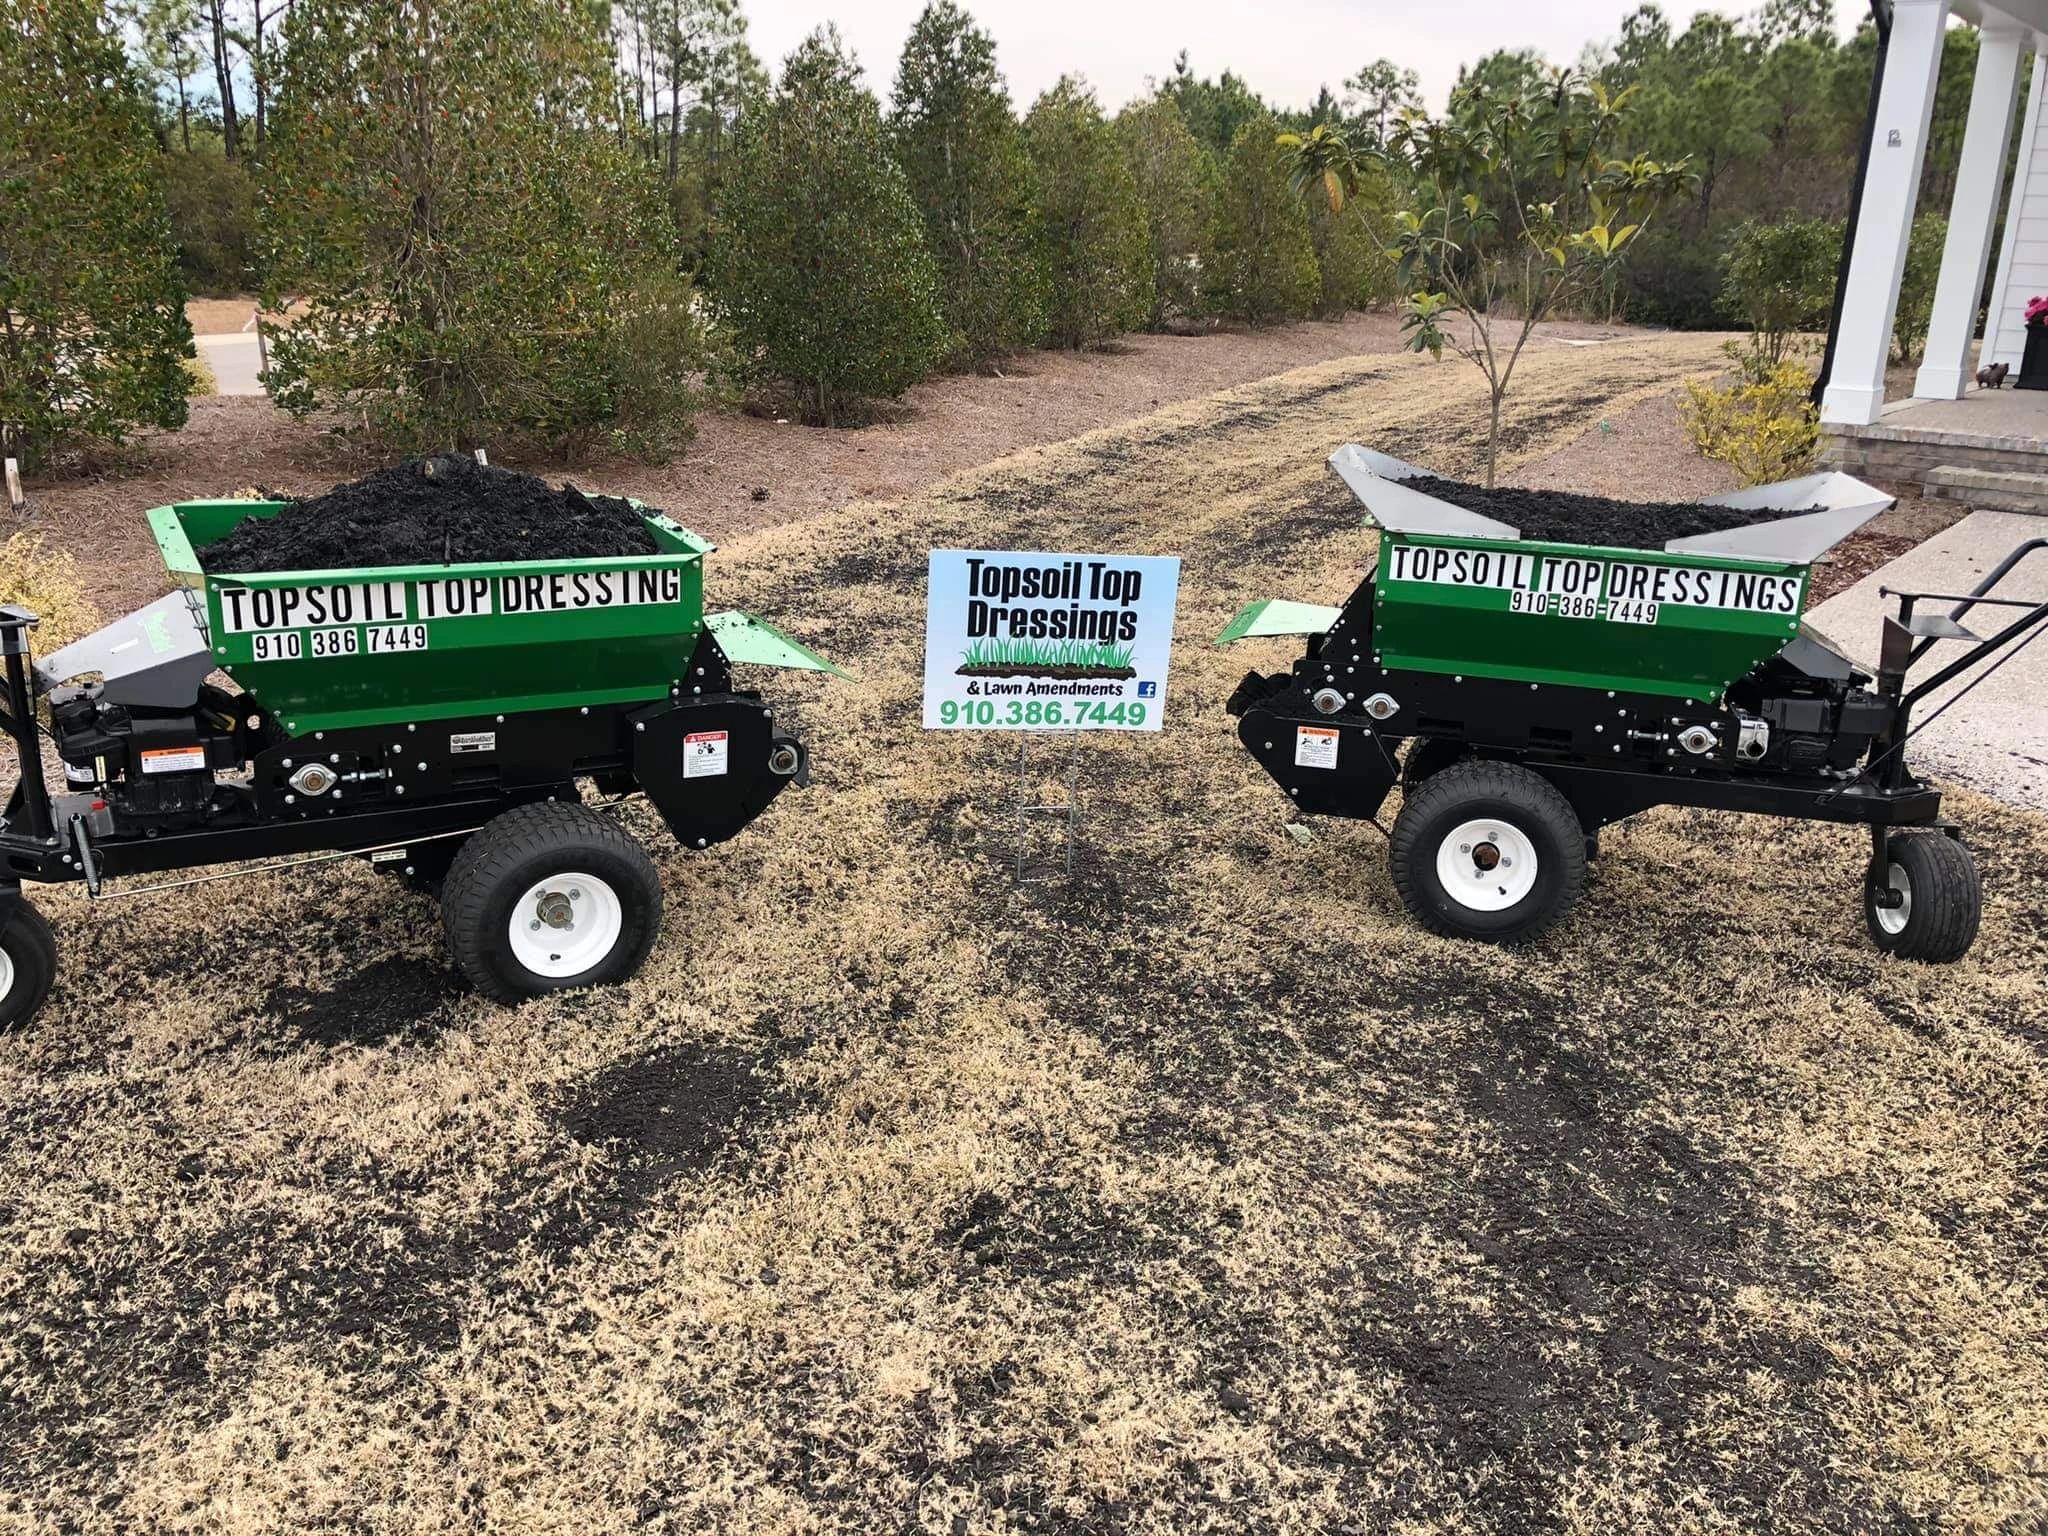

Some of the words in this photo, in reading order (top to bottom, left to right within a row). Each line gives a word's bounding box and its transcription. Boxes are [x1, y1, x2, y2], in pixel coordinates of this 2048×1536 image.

[223, 582, 403, 631] TOPSOIL
[419, 578, 488, 617] TOP
[502, 567, 679, 613] DRESSING
[966, 558, 1082, 603] Topsoil
[1088, 562, 1142, 607] Top
[1394, 546, 1526, 589] TOPSOIL
[1543, 559, 1600, 595] TOP
[1609, 564, 1797, 612] DRESSINGS
[255, 633, 301, 659] 910
[312, 629, 356, 656] 386
[368, 625, 426, 652] 7449
[966, 600, 1138, 646] Dressings
[966, 681, 980, 695] &
[984, 681, 1022, 696] Lawn
[1025, 682, 1123, 697] Amendments
[940, 700, 1146, 726] 910.386.7449
